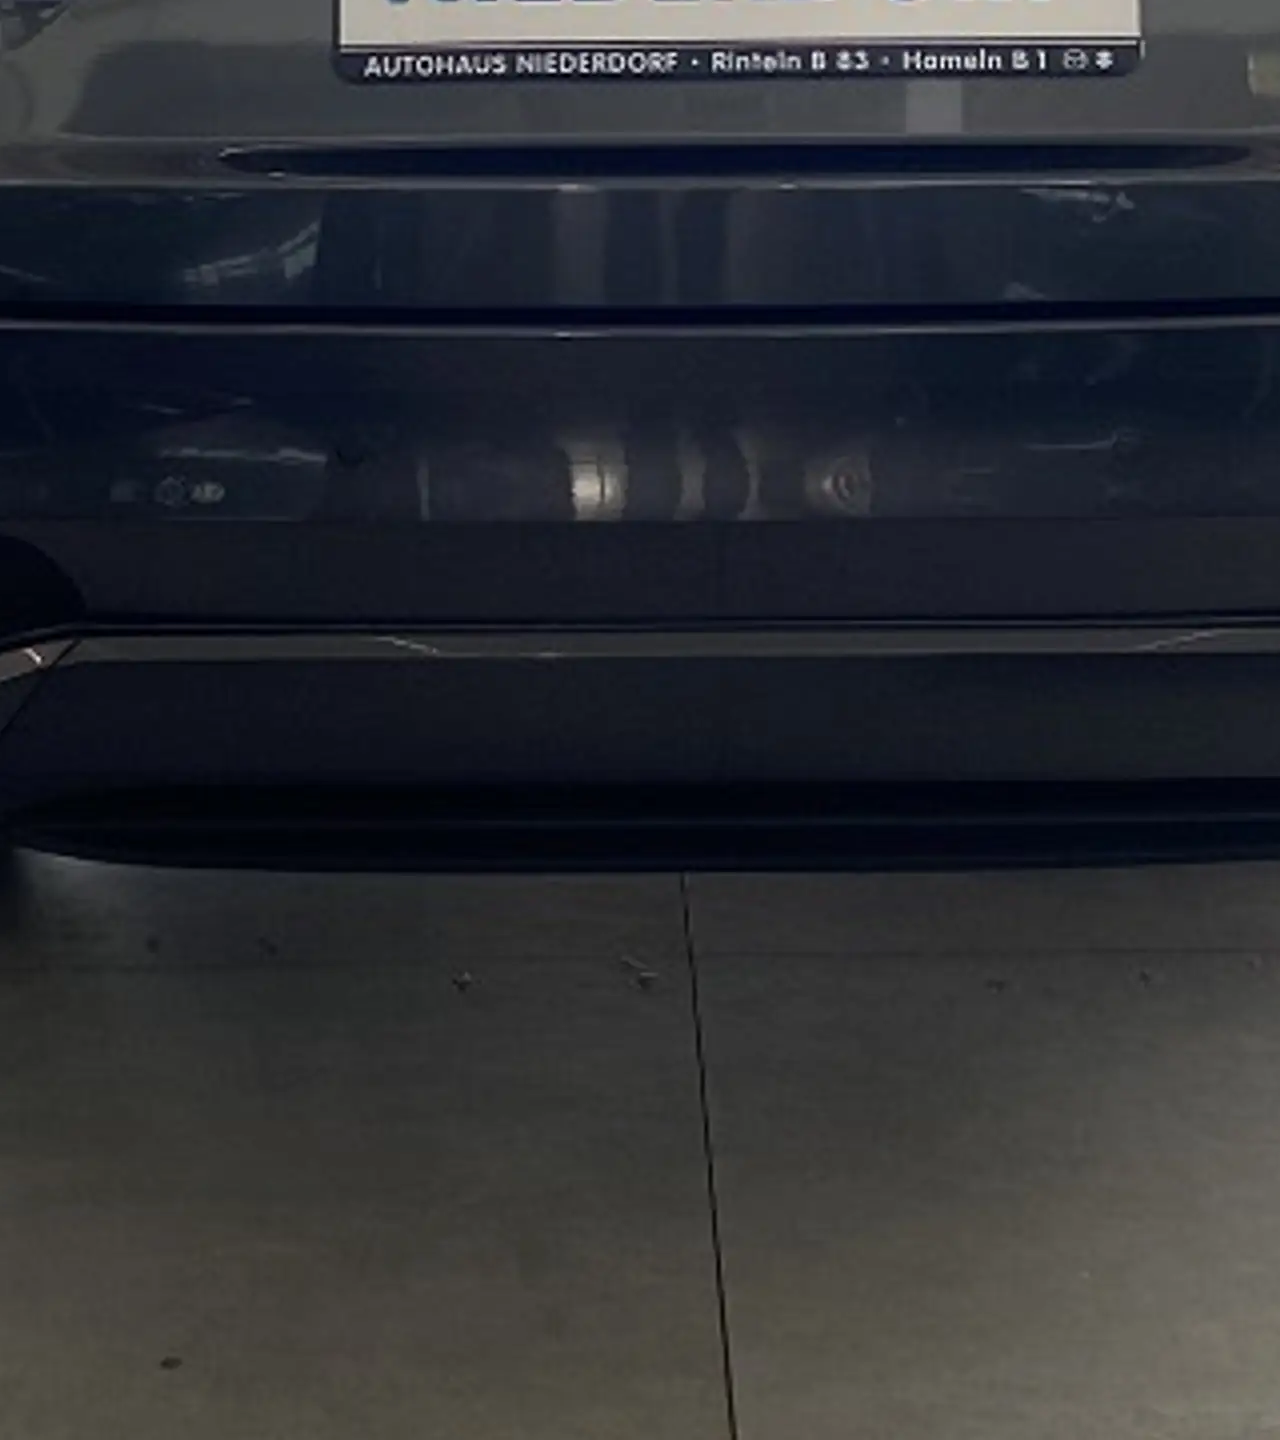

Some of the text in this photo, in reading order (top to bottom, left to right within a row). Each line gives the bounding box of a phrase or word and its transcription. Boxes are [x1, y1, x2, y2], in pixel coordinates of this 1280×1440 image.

[363, 51, 506, 77] AUTOHAUS
[515, 50, 679, 75] NIEDERDORF
[710, 50, 802, 72] Rinteln
